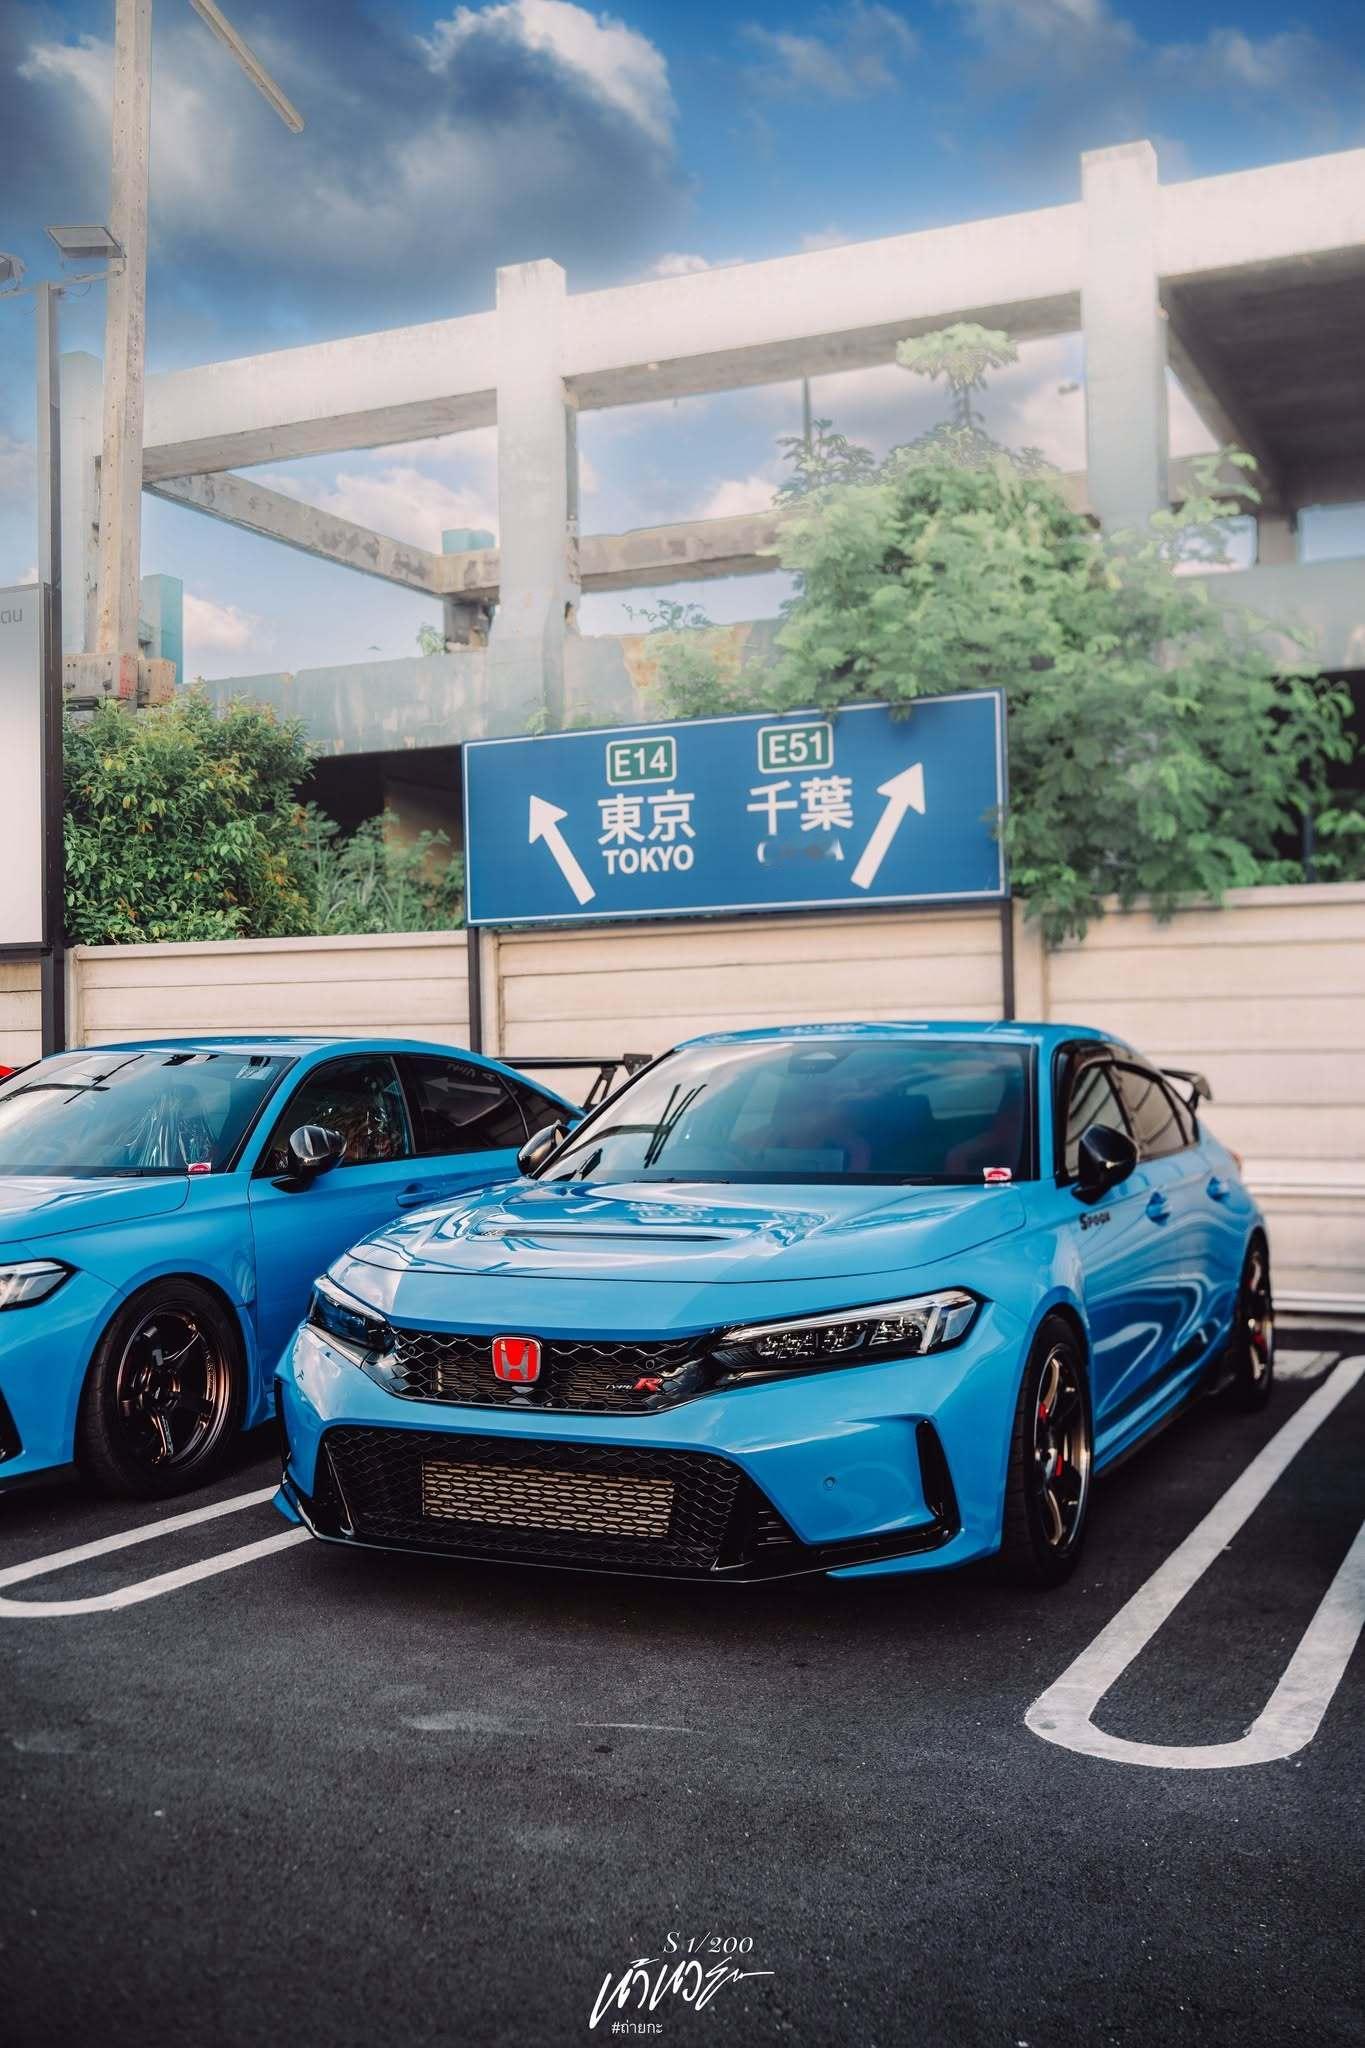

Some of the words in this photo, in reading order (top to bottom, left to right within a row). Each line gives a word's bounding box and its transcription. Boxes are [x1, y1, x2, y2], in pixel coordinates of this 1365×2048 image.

[614, 746, 668, 777] E14
[768, 729, 825, 764] E51
[597, 789, 696, 845] 東京
[746, 775, 854, 836] 千葉
[602, 844, 694, 875] TOKYO
[633, 1376, 662, 1392] R
